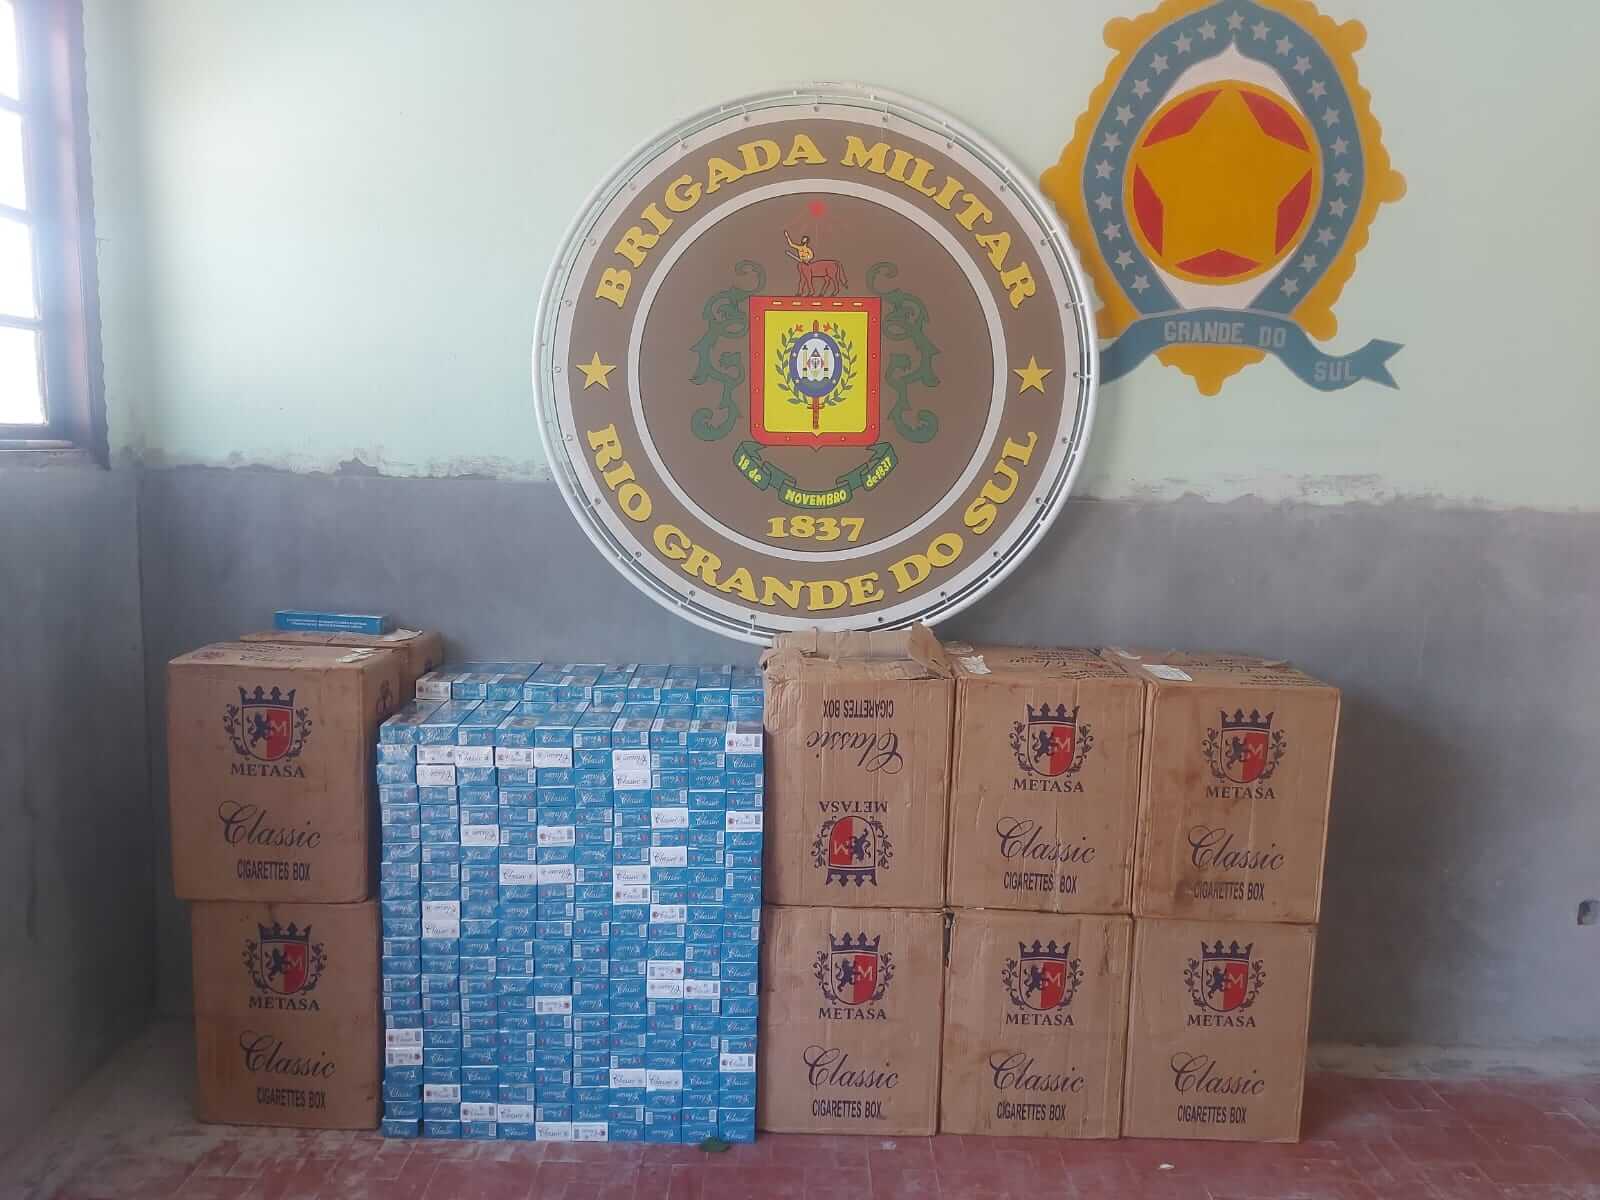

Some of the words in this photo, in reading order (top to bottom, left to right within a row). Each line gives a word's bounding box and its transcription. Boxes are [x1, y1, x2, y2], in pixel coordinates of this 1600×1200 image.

[595, 134, 827, 308] BRIGADA
[841, 136, 1037, 308] MILITAR
[1164, 321, 1244, 344] GRANDE
[1258, 326, 1286, 348] DO
[1313, 360, 1355, 382] SUL
[738, 454, 750, 470] 18
[749, 468, 762, 482] de
[785, 489, 847, 506] NOVEMBRO
[586, 424, 652, 522] RIO
[652, 524, 885, 611] GRANDE
[889, 533, 964, 592] DO
[963, 431, 1038, 534] SUL
[766, 515, 865, 542] 1837
[823, 699, 842, 718] BOX
[843, 699, 894, 718] CIGARETTES
[806, 727, 904, 775] Classic
[230, 763, 305, 778] METASA
[1012, 778, 1084, 793] METASA
[1205, 785, 1276, 800] METASA
[819, 800, 888, 813] METASA
[218, 800, 321, 849] Classic
[996, 816, 1095, 865] Classic
[1187, 825, 1286, 871] Classic
[237, 859, 290, 881] CIGARETTES
[293, 862, 311, 881] BOX
[1003, 872, 1053, 891] CIGARETTES
[1059, 875, 1077, 894] BOX
[1193, 880, 1244, 899] CIGARETTES
[1247, 882, 1264, 900] BOX
[249, 996, 320, 1010] METASA
[818, 1007, 887, 1020] METASA
[1005, 1013, 1074, 1026] METASA
[1187, 1014, 1256, 1028] METASA
[240, 1030, 336, 1079] Classic
[803, 1045, 899, 1090] Classic
[989, 1051, 1086, 1095] Classic
[1170, 1051, 1265, 1096] Classic
[308, 1090, 326, 1110] BOX
[812, 1099, 861, 1118] CIGARETTES
[865, 1099, 882, 1118] BOX
[996, 1102, 1046, 1121] CIGARETTES
[1049, 1104, 1066, 1121] BOX
[1177, 1103, 1227, 1123] CIGARETTES
[1230, 1106, 1247, 1124] BOX
